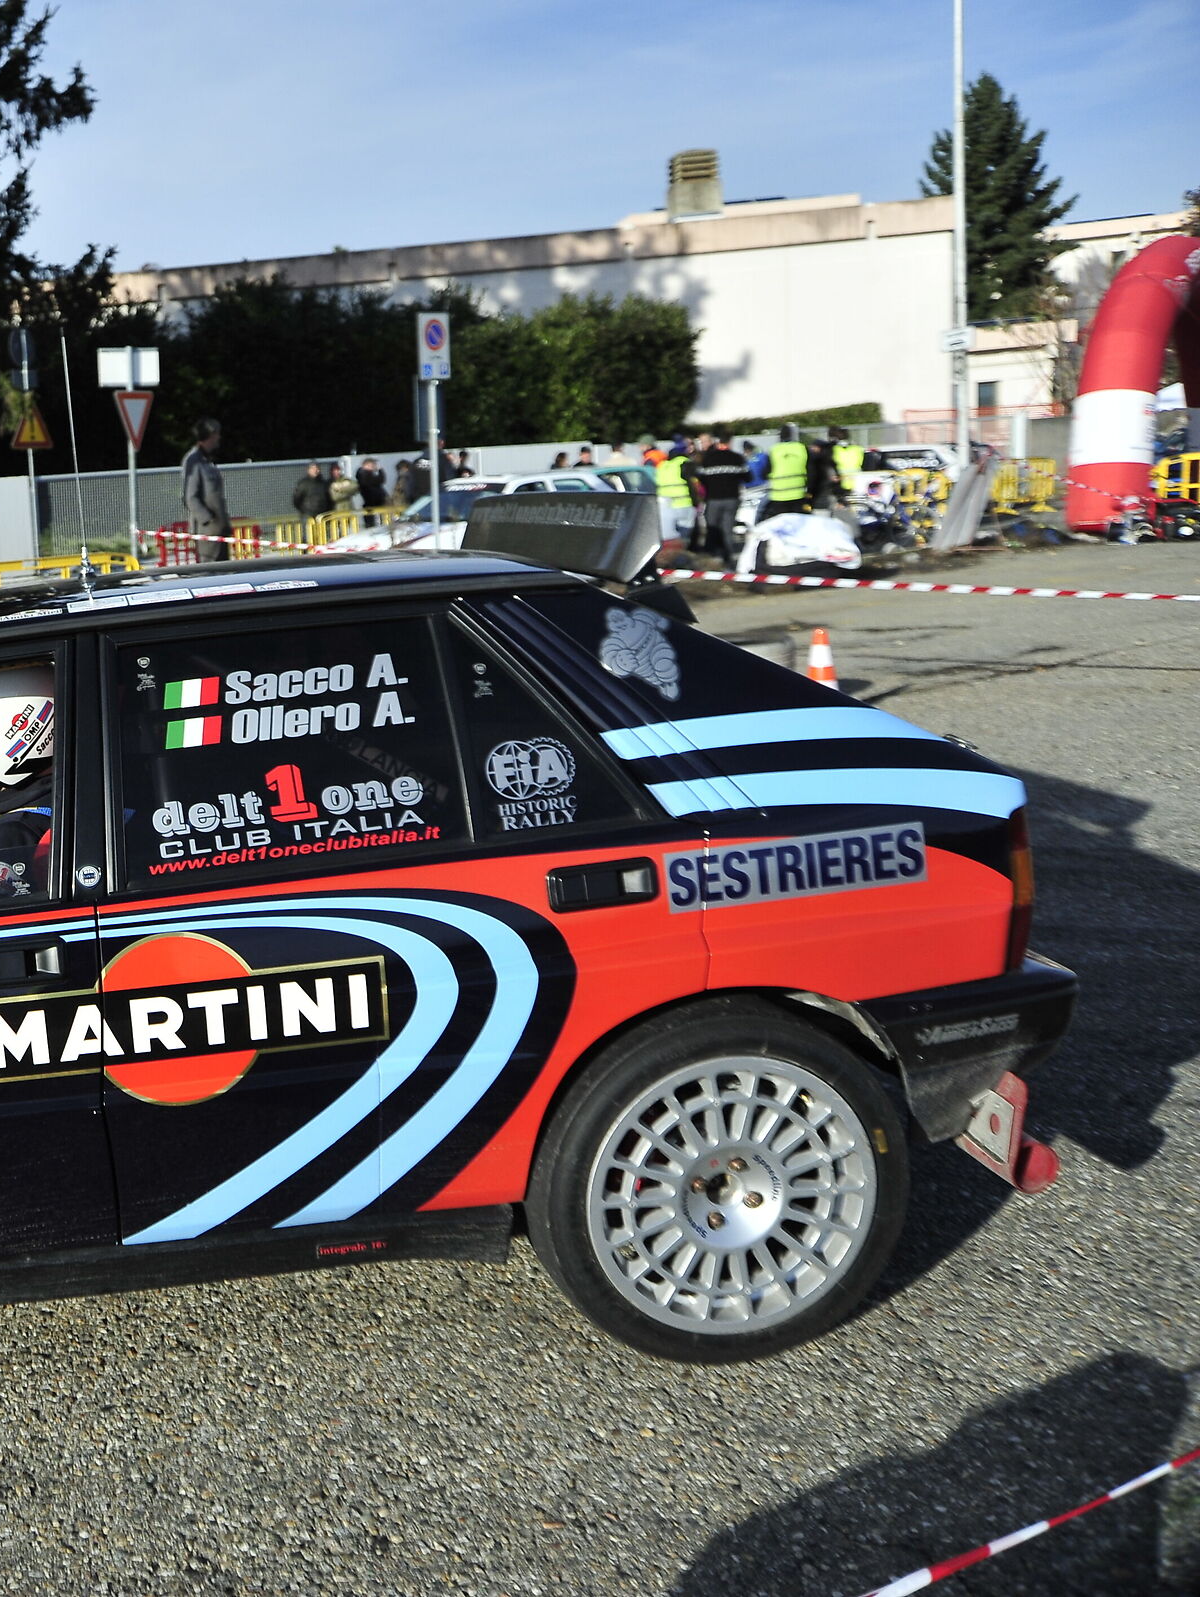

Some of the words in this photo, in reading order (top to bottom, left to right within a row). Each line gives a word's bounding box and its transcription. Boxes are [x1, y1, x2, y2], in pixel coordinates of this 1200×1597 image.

[225, 664, 354, 705] Sacco
[366, 653, 409, 688] A.
[5, 704, 35, 740] MARTINI
[25, 721, 41, 742] OMP
[231, 702, 361, 744] Ollero
[372, 691, 416, 728] A.
[499, 795, 577, 817] HISTORIC
[502, 809, 577, 831] RALLY
[149, 826, 441, 875] www.delt1oneclubitalia.it
[159, 828, 271, 859] CLUB
[294, 809, 425, 840] ITALIA
[668, 828, 925, 907] SESTRIERES
[319, 1242, 367, 1255] integrale
